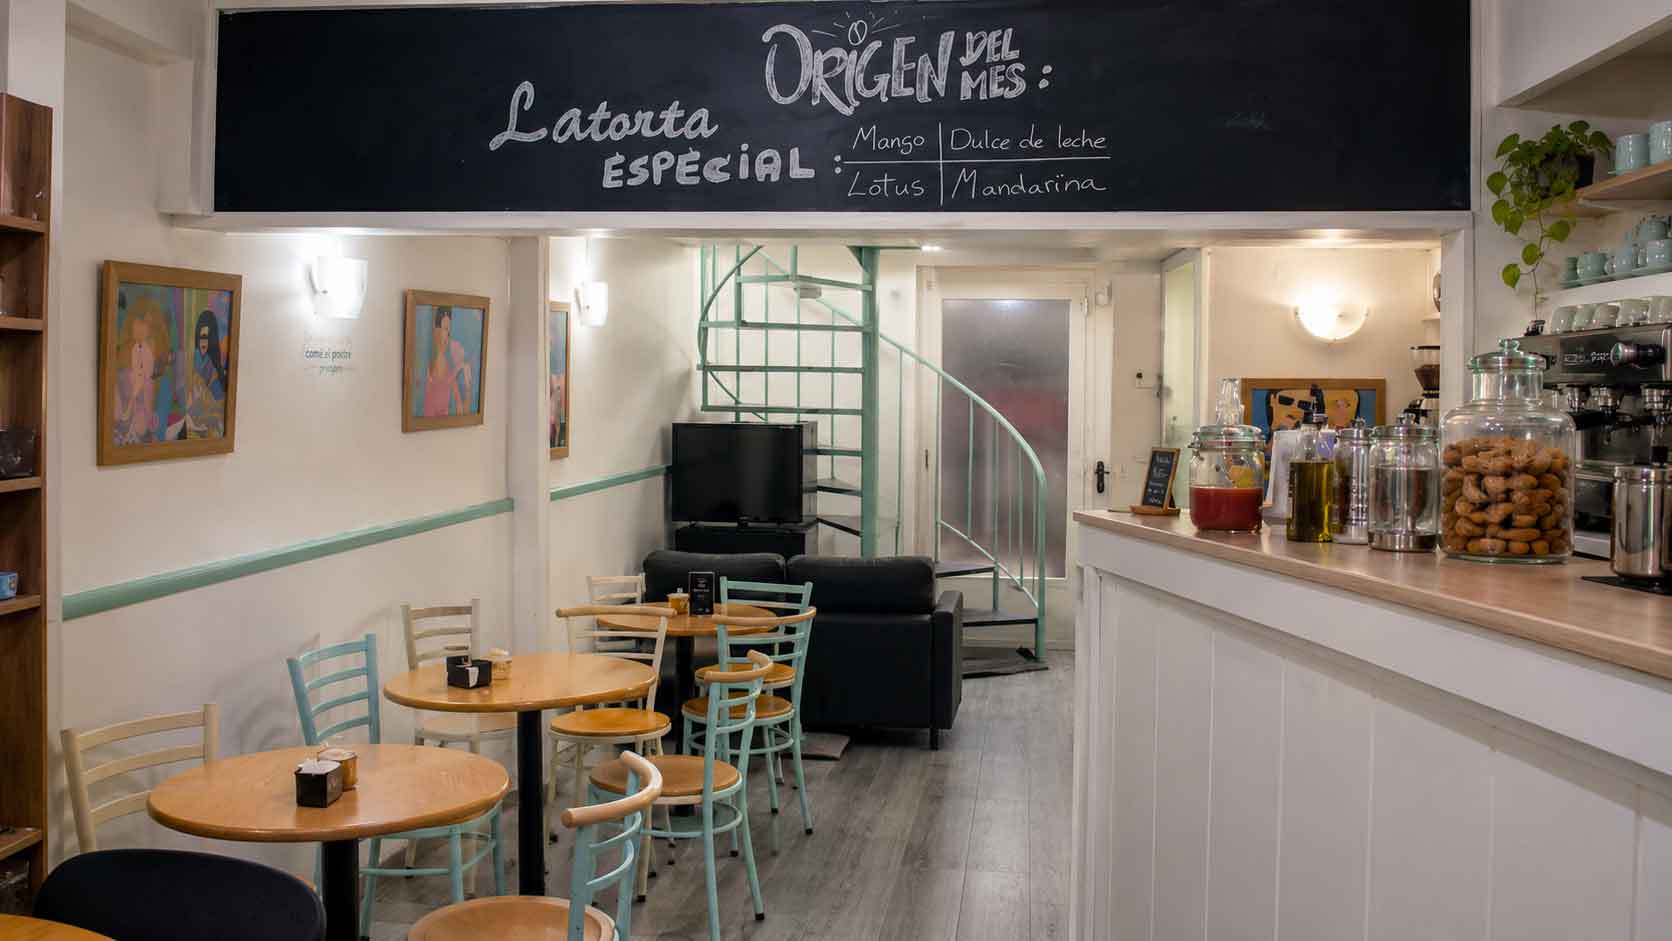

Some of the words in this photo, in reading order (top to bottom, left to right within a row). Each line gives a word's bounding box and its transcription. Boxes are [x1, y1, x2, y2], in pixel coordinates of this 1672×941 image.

[959, 28, 1021, 66] DEL
[852, 124, 925, 155] Mango
[950, 127, 1011, 151] Dulce
[1018, 123, 1044, 149] de
[1057, 124, 1107, 149] leche
[847, 173, 925, 198] Lotus
